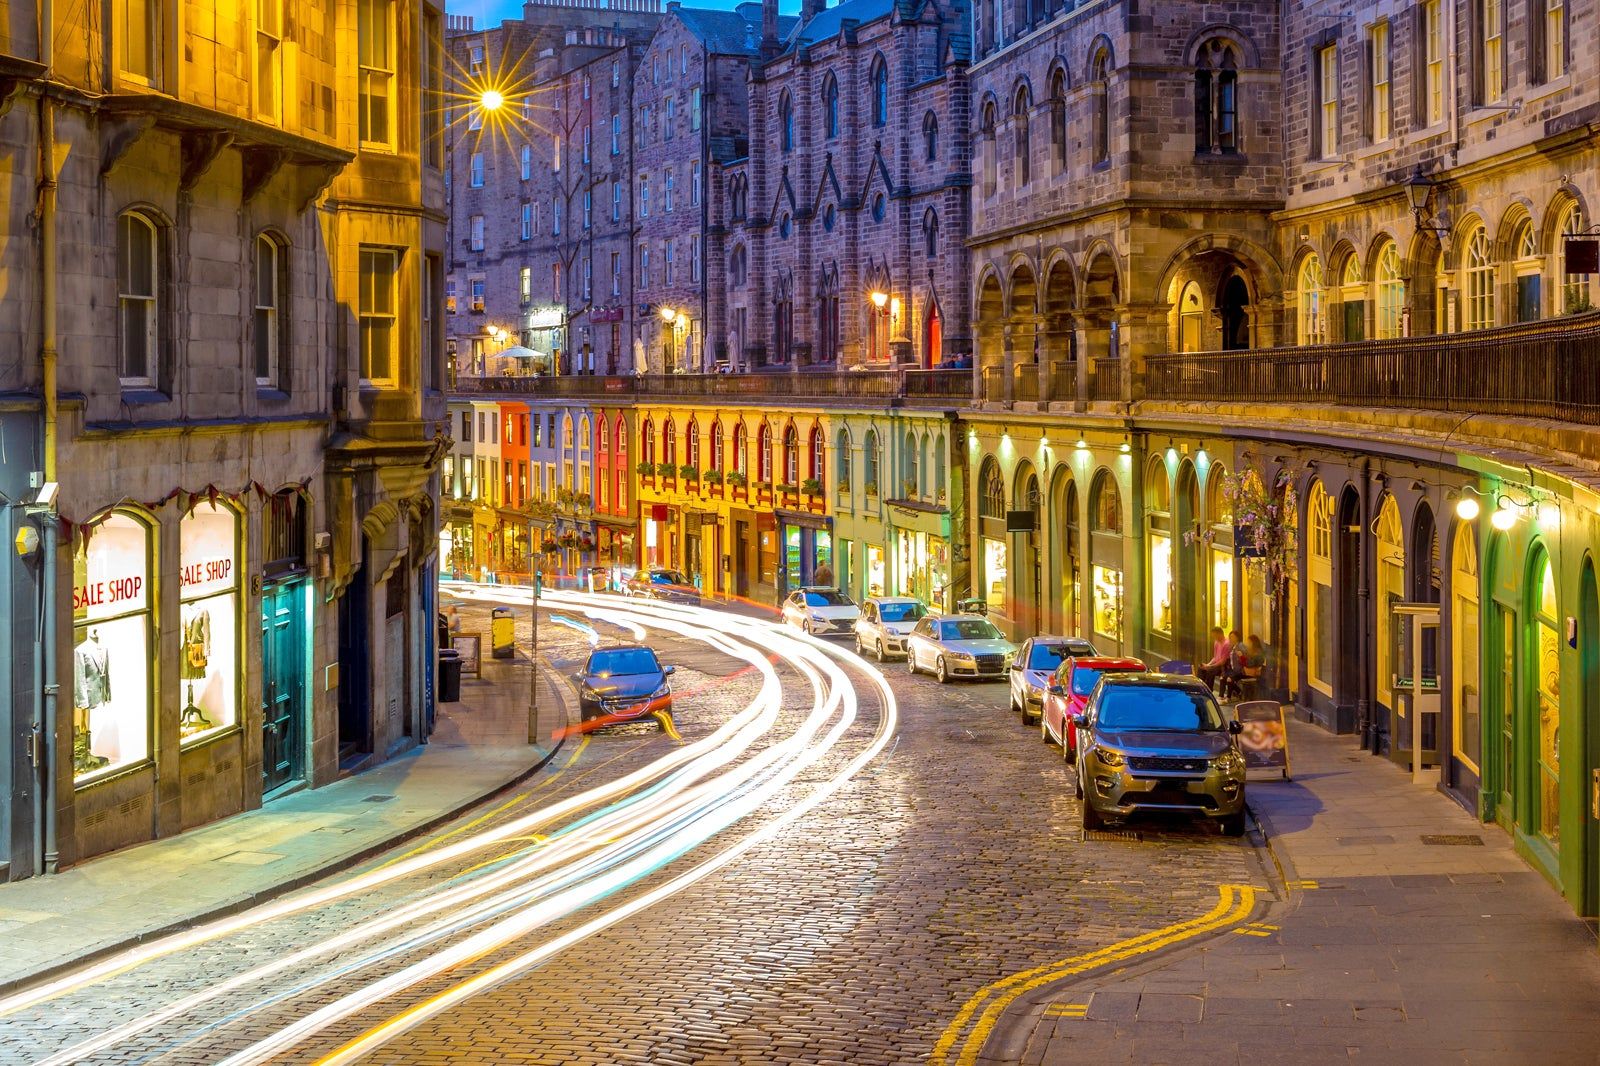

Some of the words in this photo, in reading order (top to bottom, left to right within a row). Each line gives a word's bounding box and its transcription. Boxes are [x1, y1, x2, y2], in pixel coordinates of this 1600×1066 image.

[179, 563, 202, 587] SALE
[206, 558, 231, 582] SHOP
[73, 582, 104, 609] SALE
[109, 576, 142, 603] SHOP
